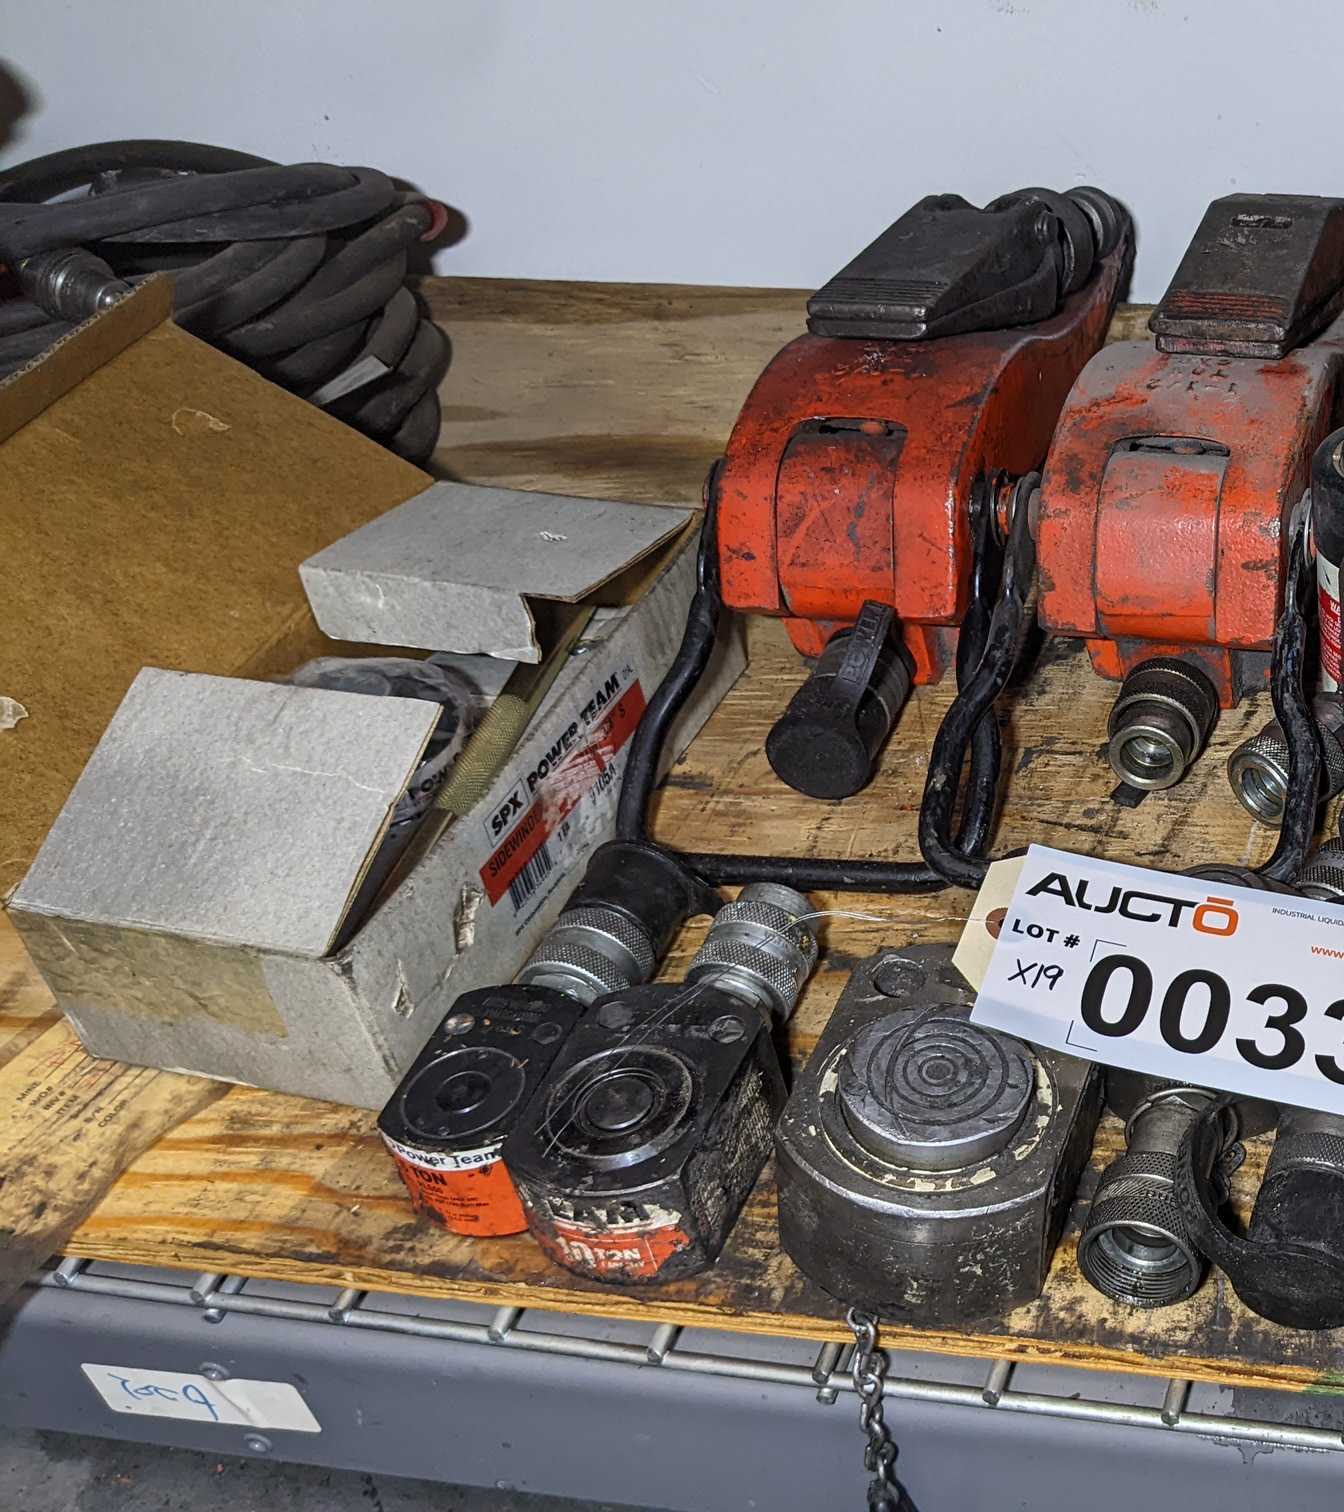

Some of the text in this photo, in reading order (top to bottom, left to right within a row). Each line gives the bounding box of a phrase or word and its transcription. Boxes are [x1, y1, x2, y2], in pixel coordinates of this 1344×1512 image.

[491, 793, 524, 836] SPX
[527, 722, 578, 793] POWER
[580, 674, 621, 726] TEAM
[1272, 907, 1316, 921] INDUSTRIAL
[1012, 918, 1081, 949] LOT #
[1008, 958, 1065, 991] X19
[98, 1099, 129, 1129] COLOR
[397, 1146, 446, 1167] Power
